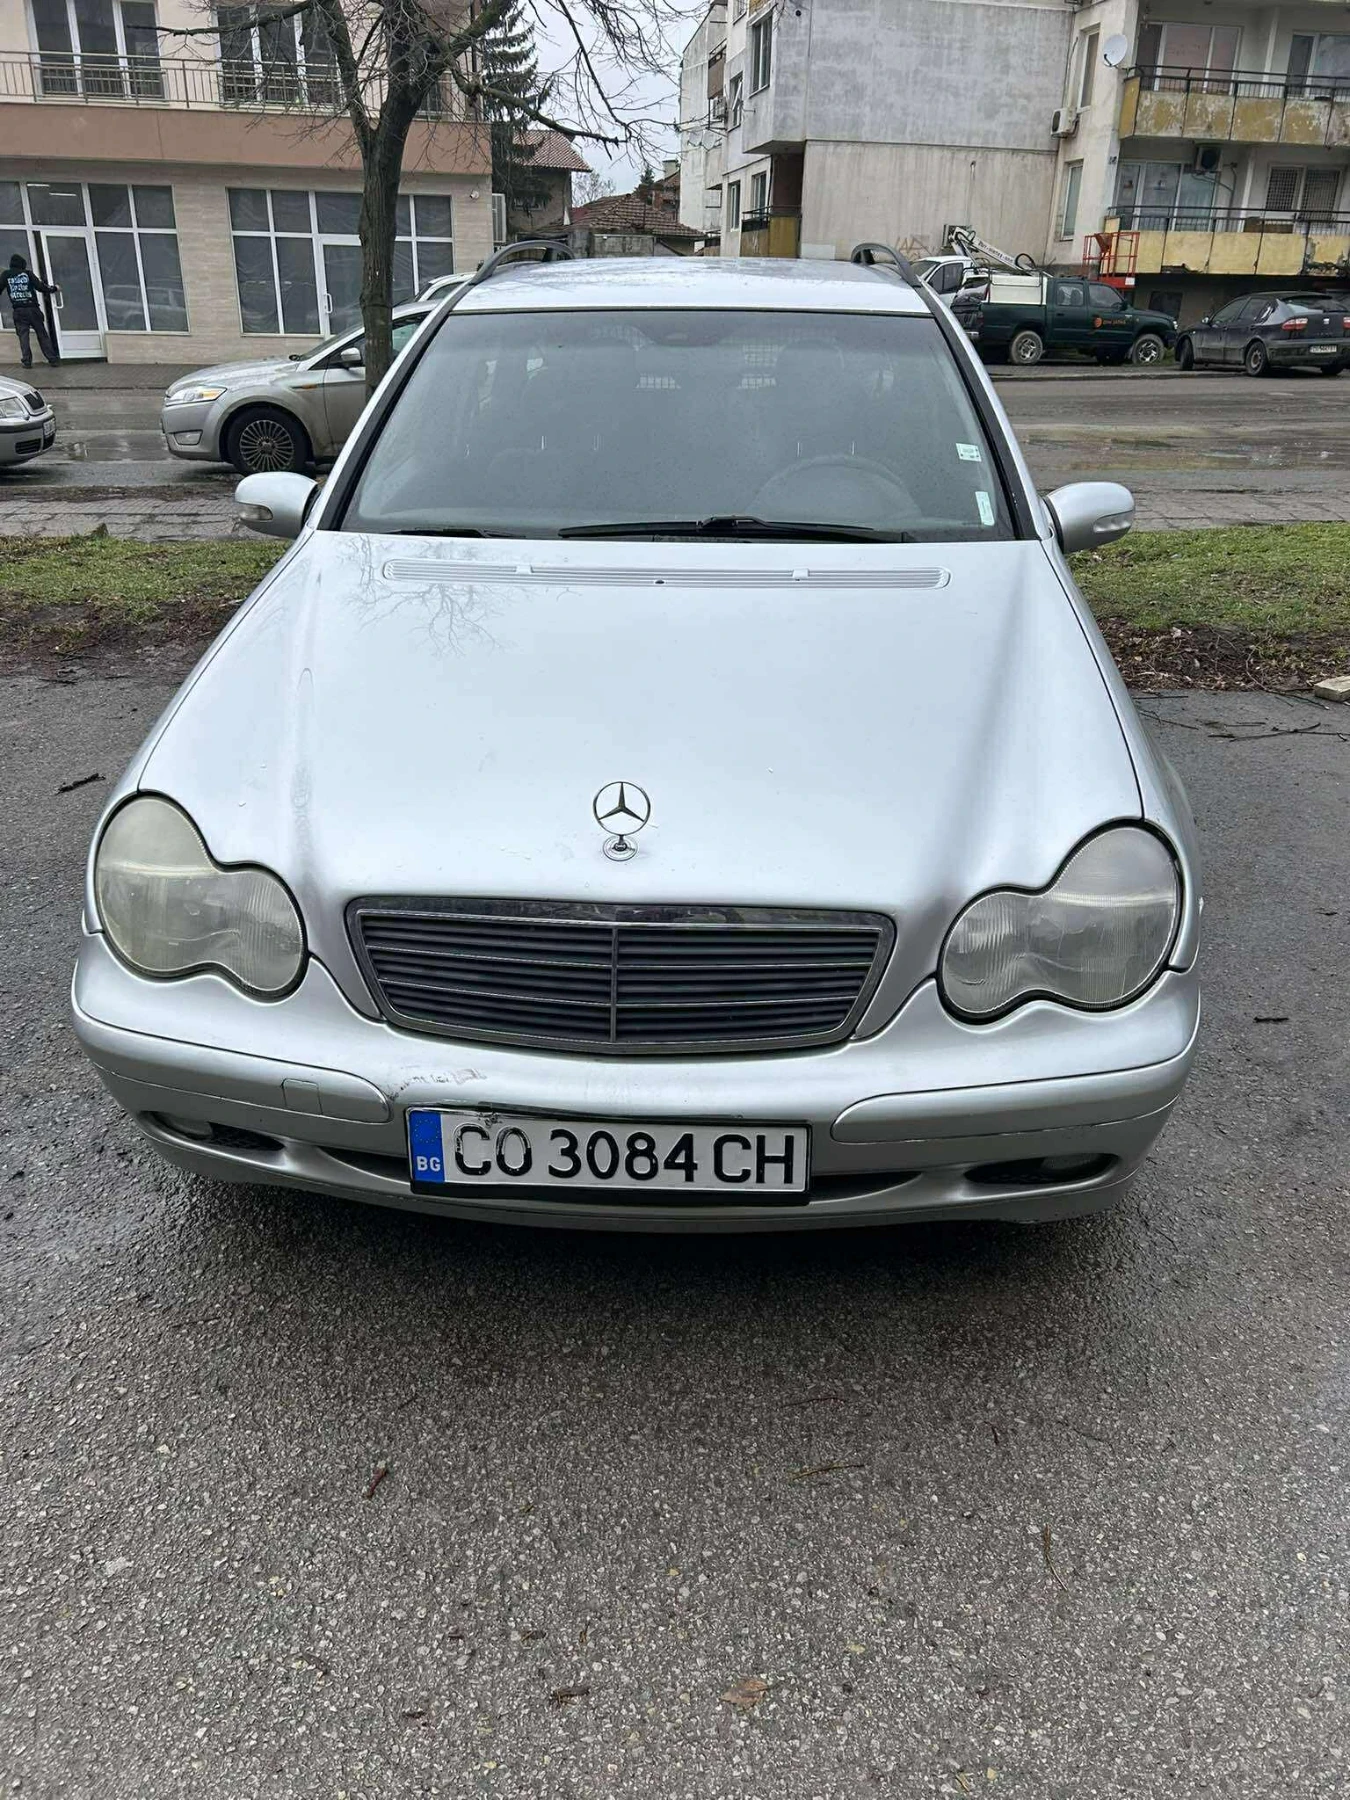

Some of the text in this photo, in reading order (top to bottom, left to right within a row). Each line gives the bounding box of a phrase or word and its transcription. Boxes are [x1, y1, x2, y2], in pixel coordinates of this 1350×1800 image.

[416, 1155, 441, 1172] BG
[453, 1122, 795, 1184] CO 3084 CH
